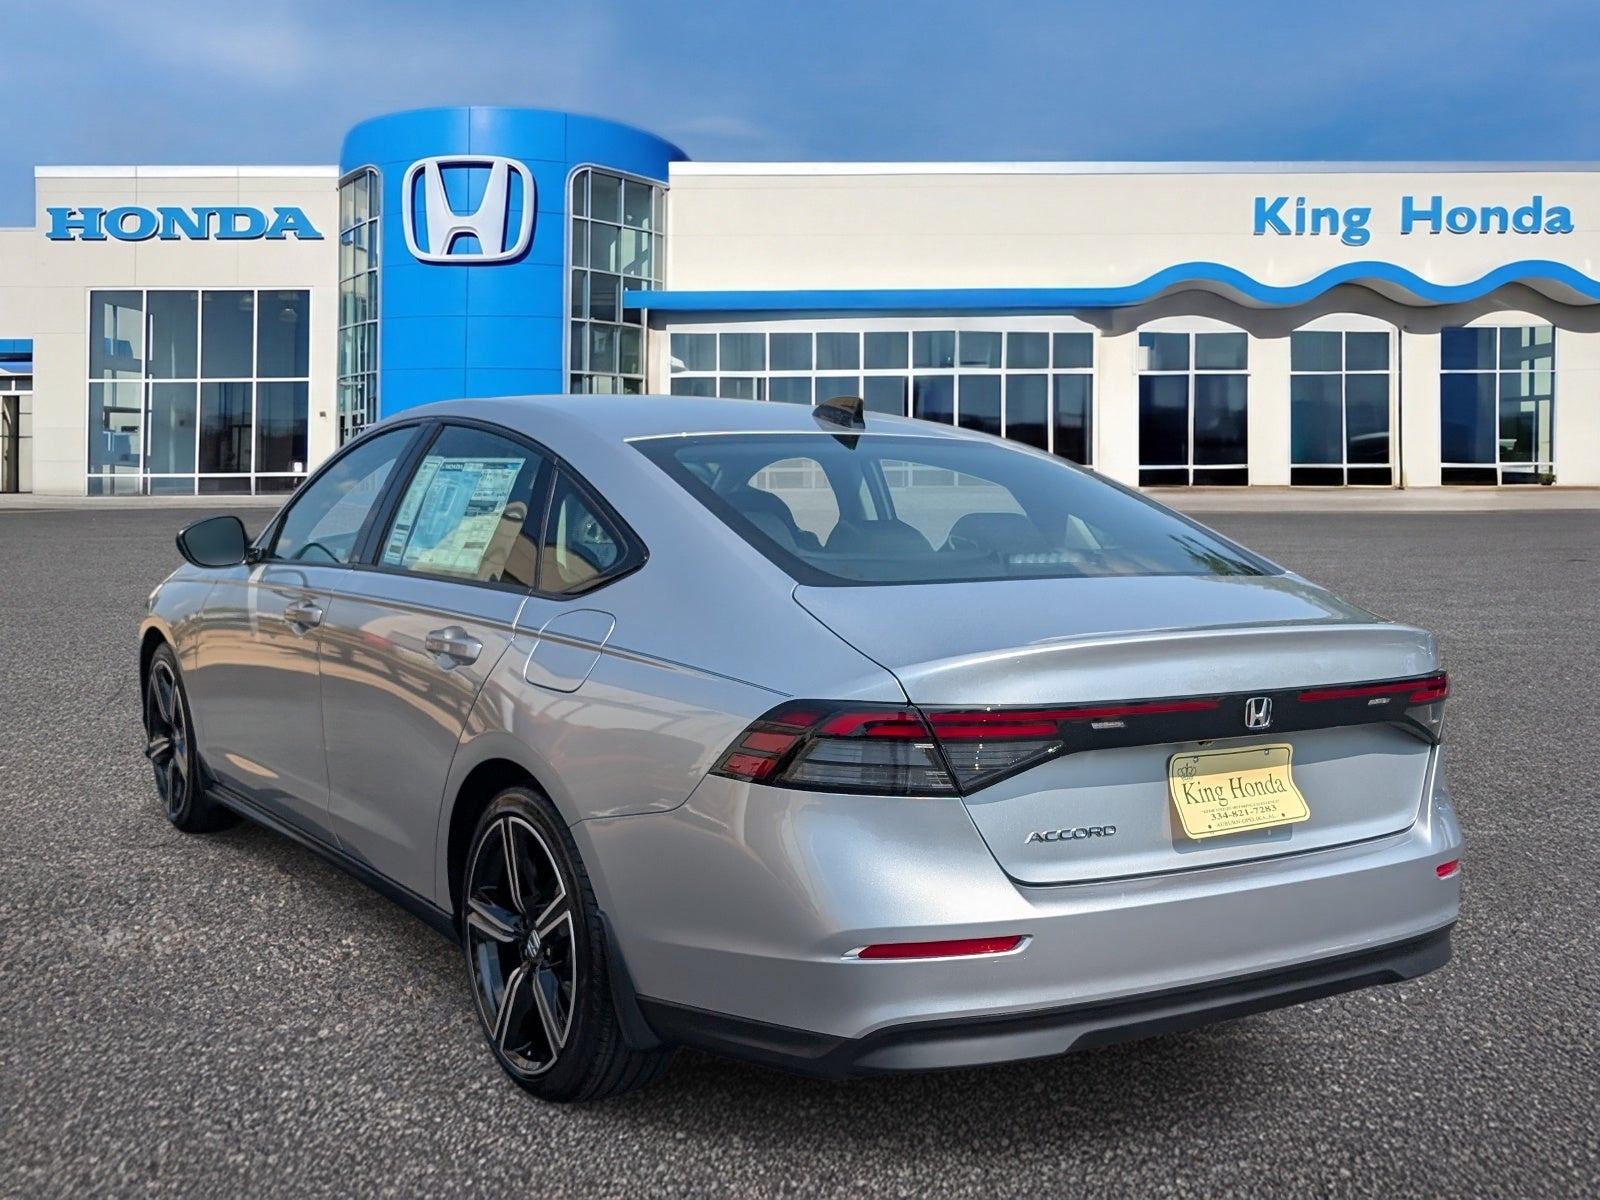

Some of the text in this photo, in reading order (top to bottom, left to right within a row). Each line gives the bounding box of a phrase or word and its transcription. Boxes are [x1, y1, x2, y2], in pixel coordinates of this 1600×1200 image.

[46, 206, 325, 241] HONDA
[1253, 195, 1575, 246] King Honda
[1182, 781, 1229, 807] King
[1228, 773, 1287, 798] Honda
[1211, 804, 1277, 821] 334-821-7283
[1024, 825, 1117, 845] ACCORD
